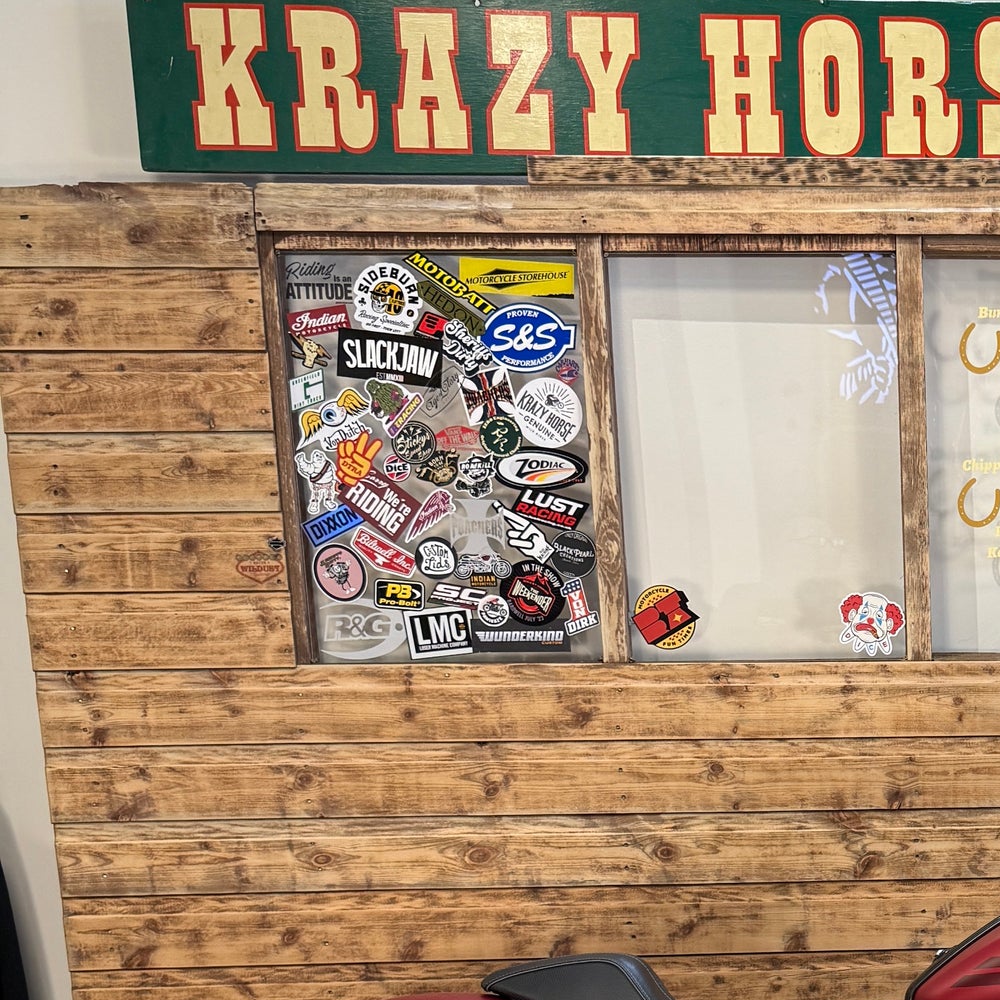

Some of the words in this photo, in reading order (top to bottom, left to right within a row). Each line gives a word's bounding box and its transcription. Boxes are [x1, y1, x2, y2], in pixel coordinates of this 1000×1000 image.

[185, 3, 641, 155] KRAZY
[286, 262, 336, 280] Riding
[408, 253, 496, 314] MOTOBATT
[465, 274, 517, 284] MOTORCYCLE
[518, 271, 567, 282] STOREHOUSE
[286, 283, 352, 300] ATTITUDE
[358, 266, 419, 305] SIDEBURN
[423, 286, 478, 331] HEDON
[506, 309, 540, 319] PROVEN
[292, 312, 347, 331] Indian
[490, 322, 559, 351] S&S
[342, 338, 439, 378] SLACKJAW
[501, 352, 555, 367] PERFORMANCE
[517, 391, 548, 420] KRAZY
[547, 411, 576, 442] HORSE
[524, 415, 555, 440] GENUINE
[386, 464, 408, 473] DICE
[515, 459, 565, 479] ZODIAC
[345, 483, 405, 534] RIDING
[516, 503, 577, 527] RACING
[521, 489, 584, 516] LUST
[310, 507, 358, 540] DIXXON
[357, 533, 397, 560] Biltwell
[521, 564, 531, 572] IN
[532, 563, 545, 573] THE
[544, 569, 561, 588] SHOW
[386, 583, 412, 599] PB
[432, 583, 487, 601] SC
[512, 580, 552, 613] WEEKENDER
[638, 588, 670, 610] MOTORCYCLE
[568, 590, 586, 618] VON
[324, 613, 392, 642] R&G
[412, 613, 467, 645] LMC
[567, 614, 598, 633] DIRK
[475, 630, 564, 643] WUNDERKIND
